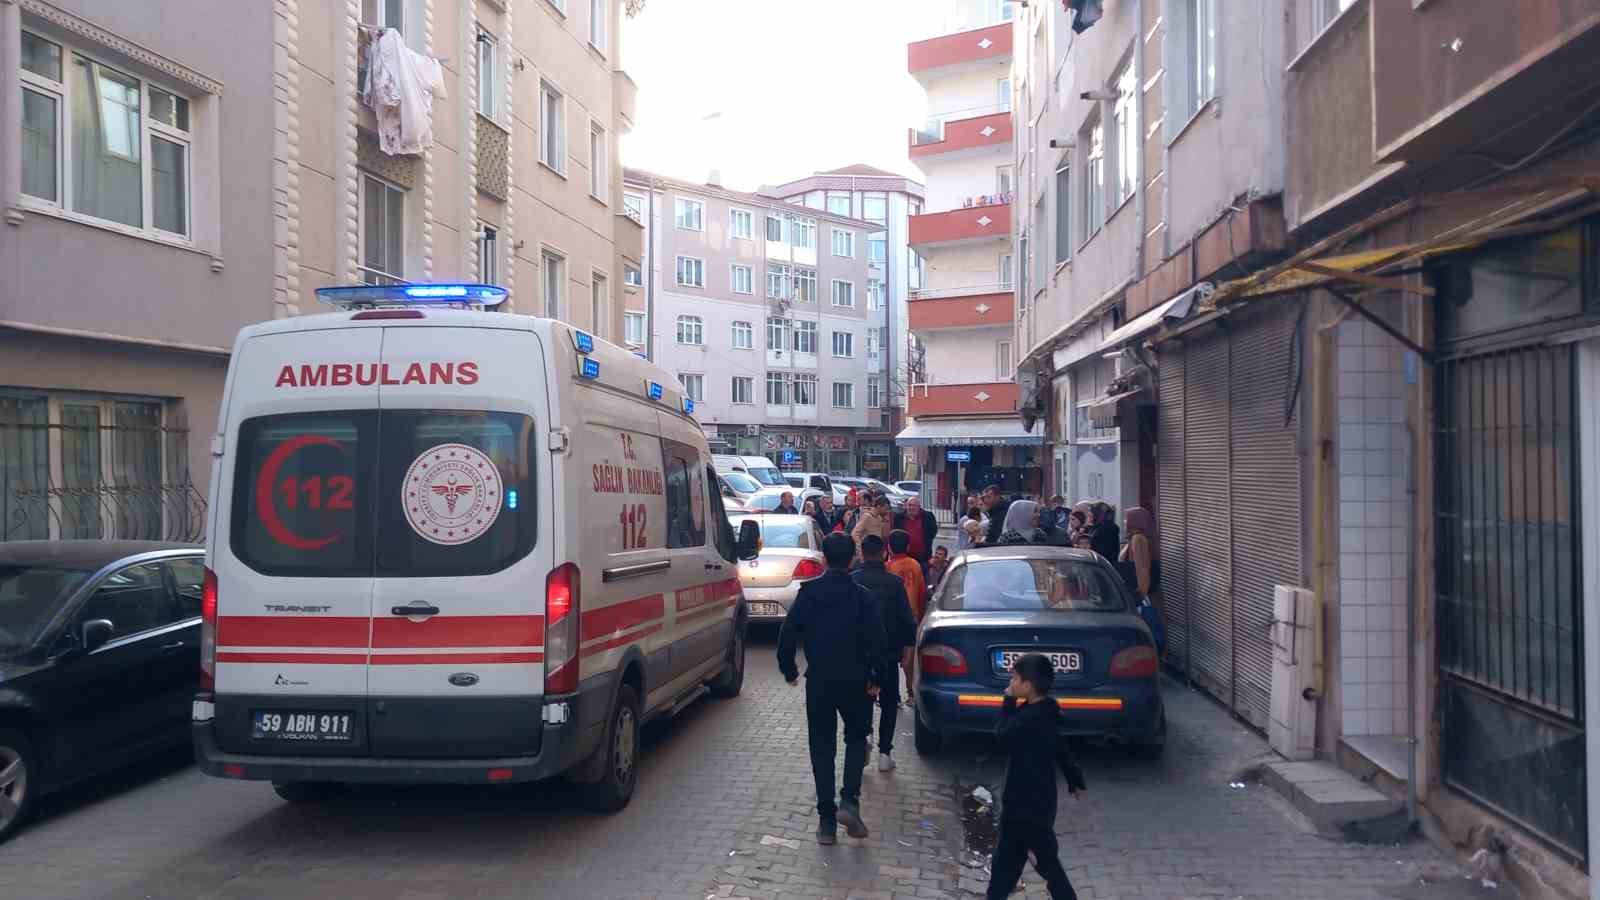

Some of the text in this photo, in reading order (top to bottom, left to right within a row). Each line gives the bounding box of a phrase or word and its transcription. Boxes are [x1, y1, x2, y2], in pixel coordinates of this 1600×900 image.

[275, 362, 479, 387] AMBULANS
[592, 459, 624, 493] SAĞLIK
[280, 475, 353, 509] 112
[620, 504, 647, 549] 112
[264, 604, 332, 613] TRANSIT
[1051, 654, 1078, 668] 606
[262, 713, 349, 734] 59 ABH 911
